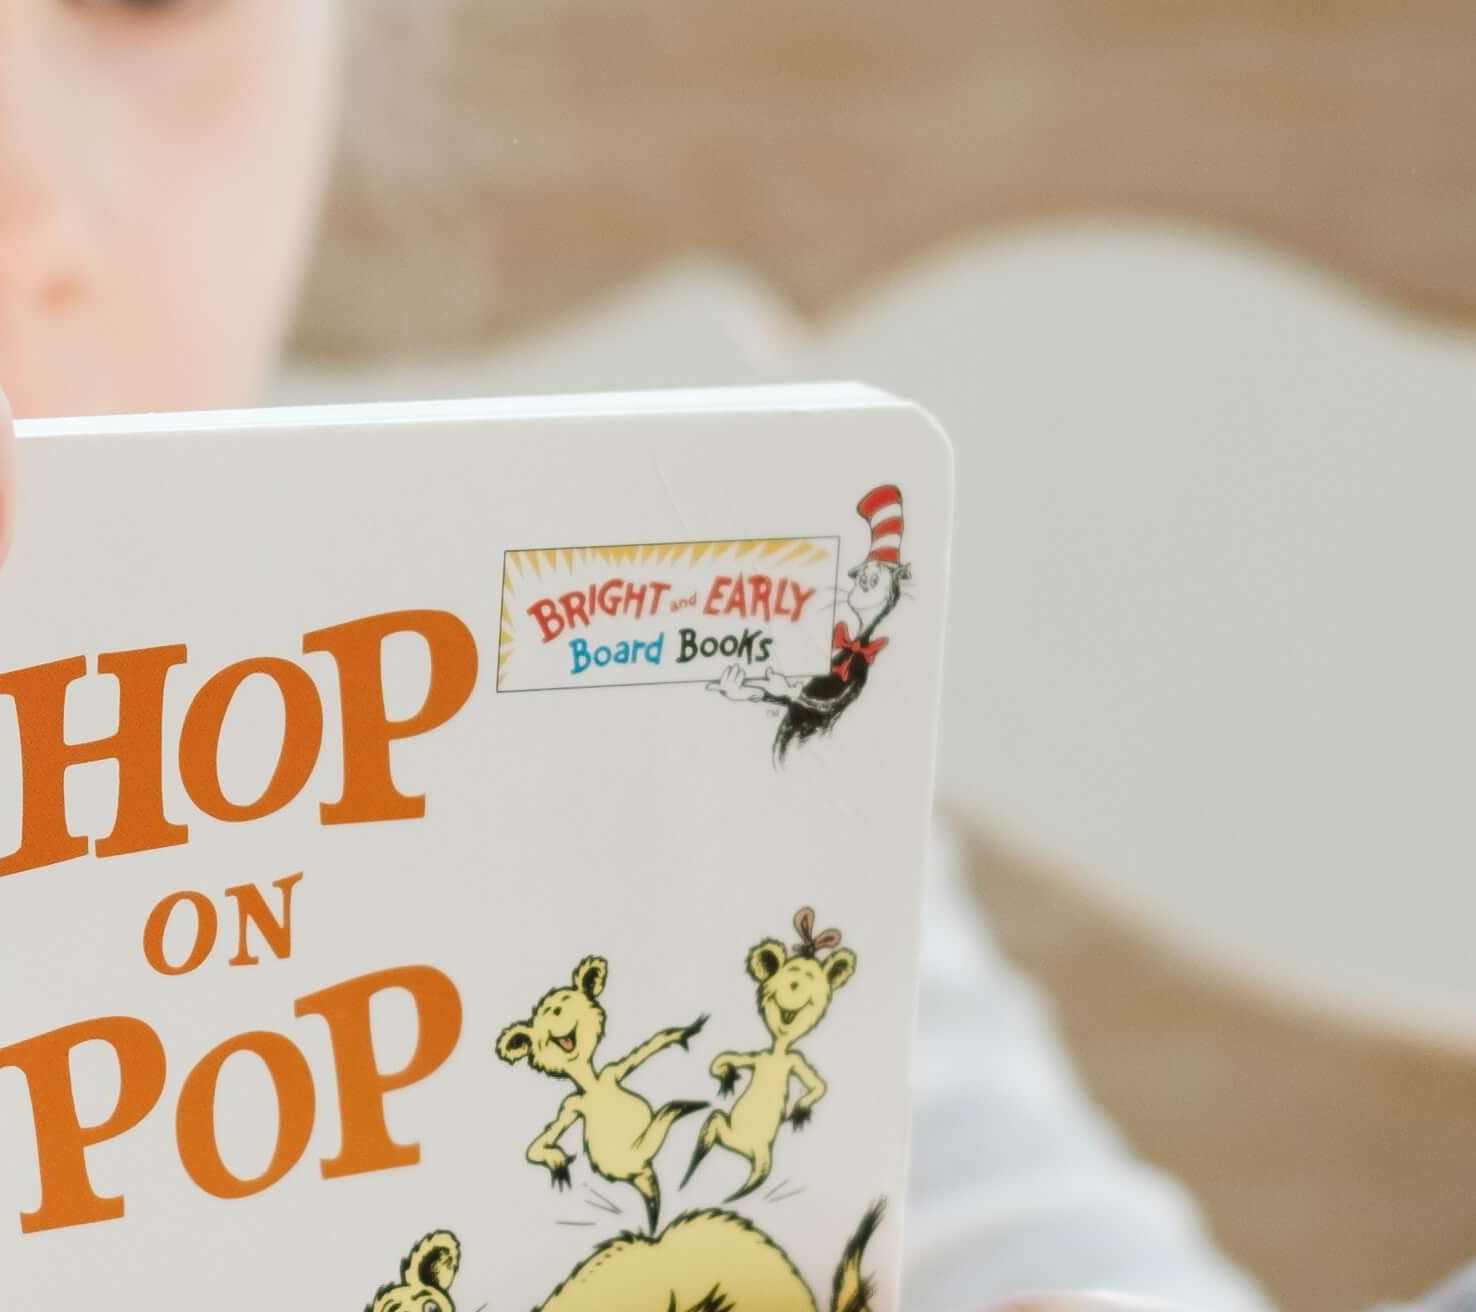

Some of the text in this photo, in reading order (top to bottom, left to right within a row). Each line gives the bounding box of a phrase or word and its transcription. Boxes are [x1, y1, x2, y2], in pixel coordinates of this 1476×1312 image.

[527, 573, 816, 644] BRIGHT and EARLY
[569, 627, 774, 675] Board Books
[142, 871, 303, 977] ON
